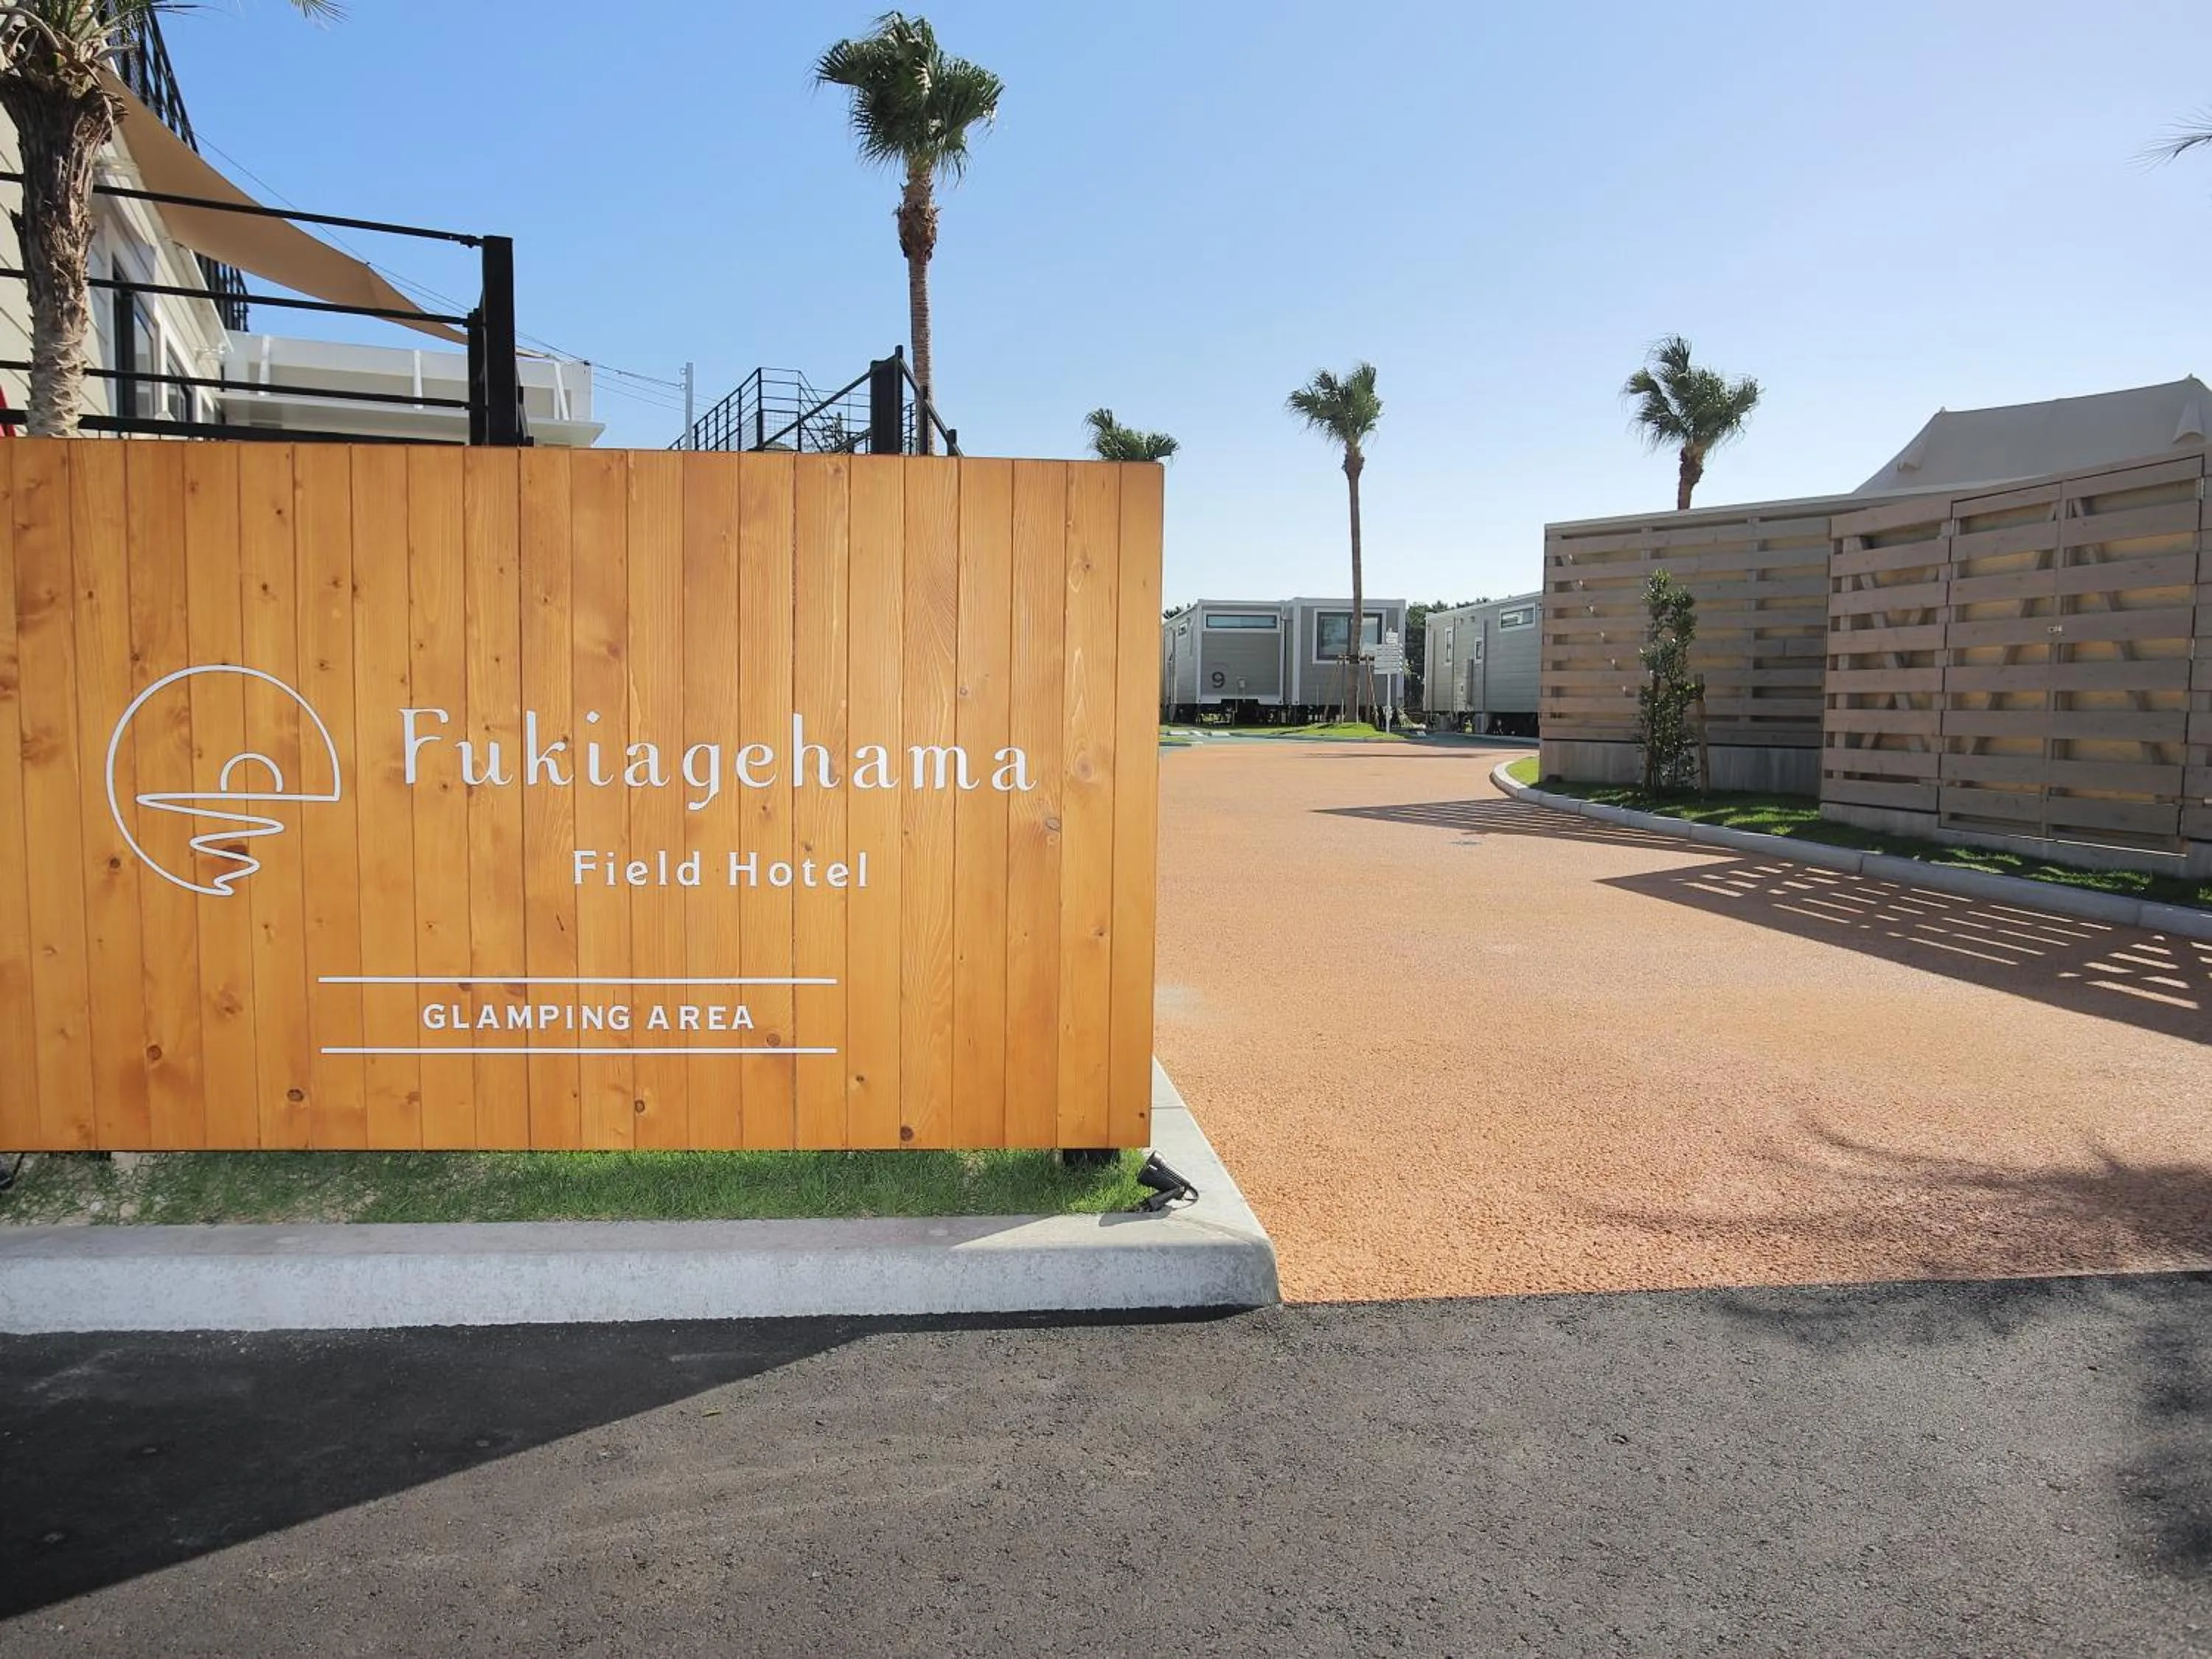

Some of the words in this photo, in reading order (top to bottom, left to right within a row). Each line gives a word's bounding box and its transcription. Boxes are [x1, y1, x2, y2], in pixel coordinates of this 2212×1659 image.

[1211, 671, 1225, 689] 9
[399, 707, 1037, 812] Fukiagehama
[572, 849, 702, 887] Field
[728, 851, 869, 888] Hotel
[422, 1003, 631, 1031] GLAMPING
[647, 1004, 755, 1031] AREA
